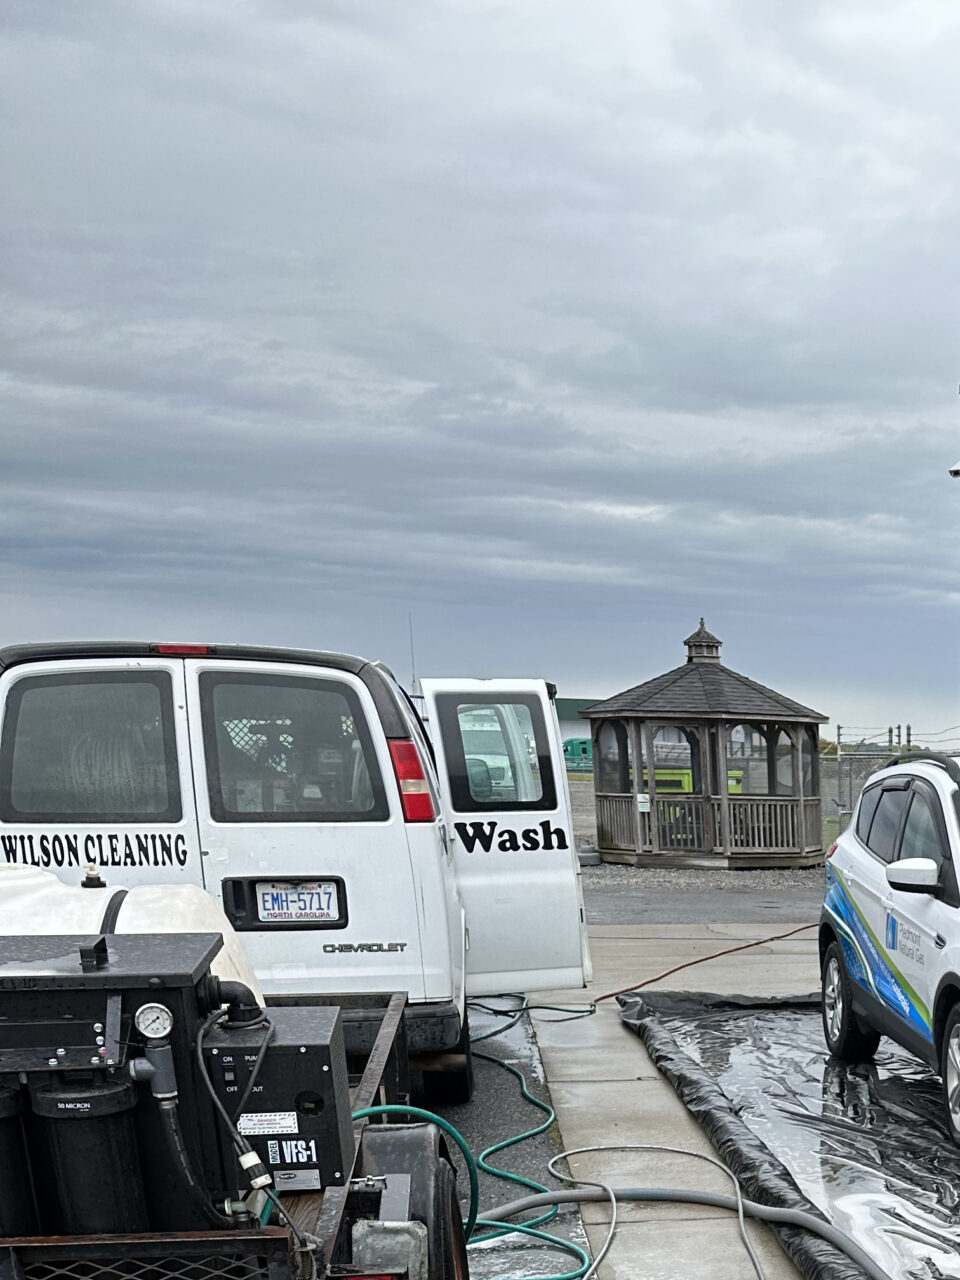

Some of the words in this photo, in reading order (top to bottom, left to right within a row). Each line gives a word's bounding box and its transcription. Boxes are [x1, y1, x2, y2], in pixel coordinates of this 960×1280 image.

[454, 820, 569, 853] Wash
[0, 834, 80, 867] WILSON
[84, 833, 188, 867] CLEANING
[262, 892, 332, 911] EMH-5717
[322, 943, 407, 953] CHEVROLET
[269, 1142, 279, 1162] MODEL
[281, 1140, 317, 1163] VFS-1
